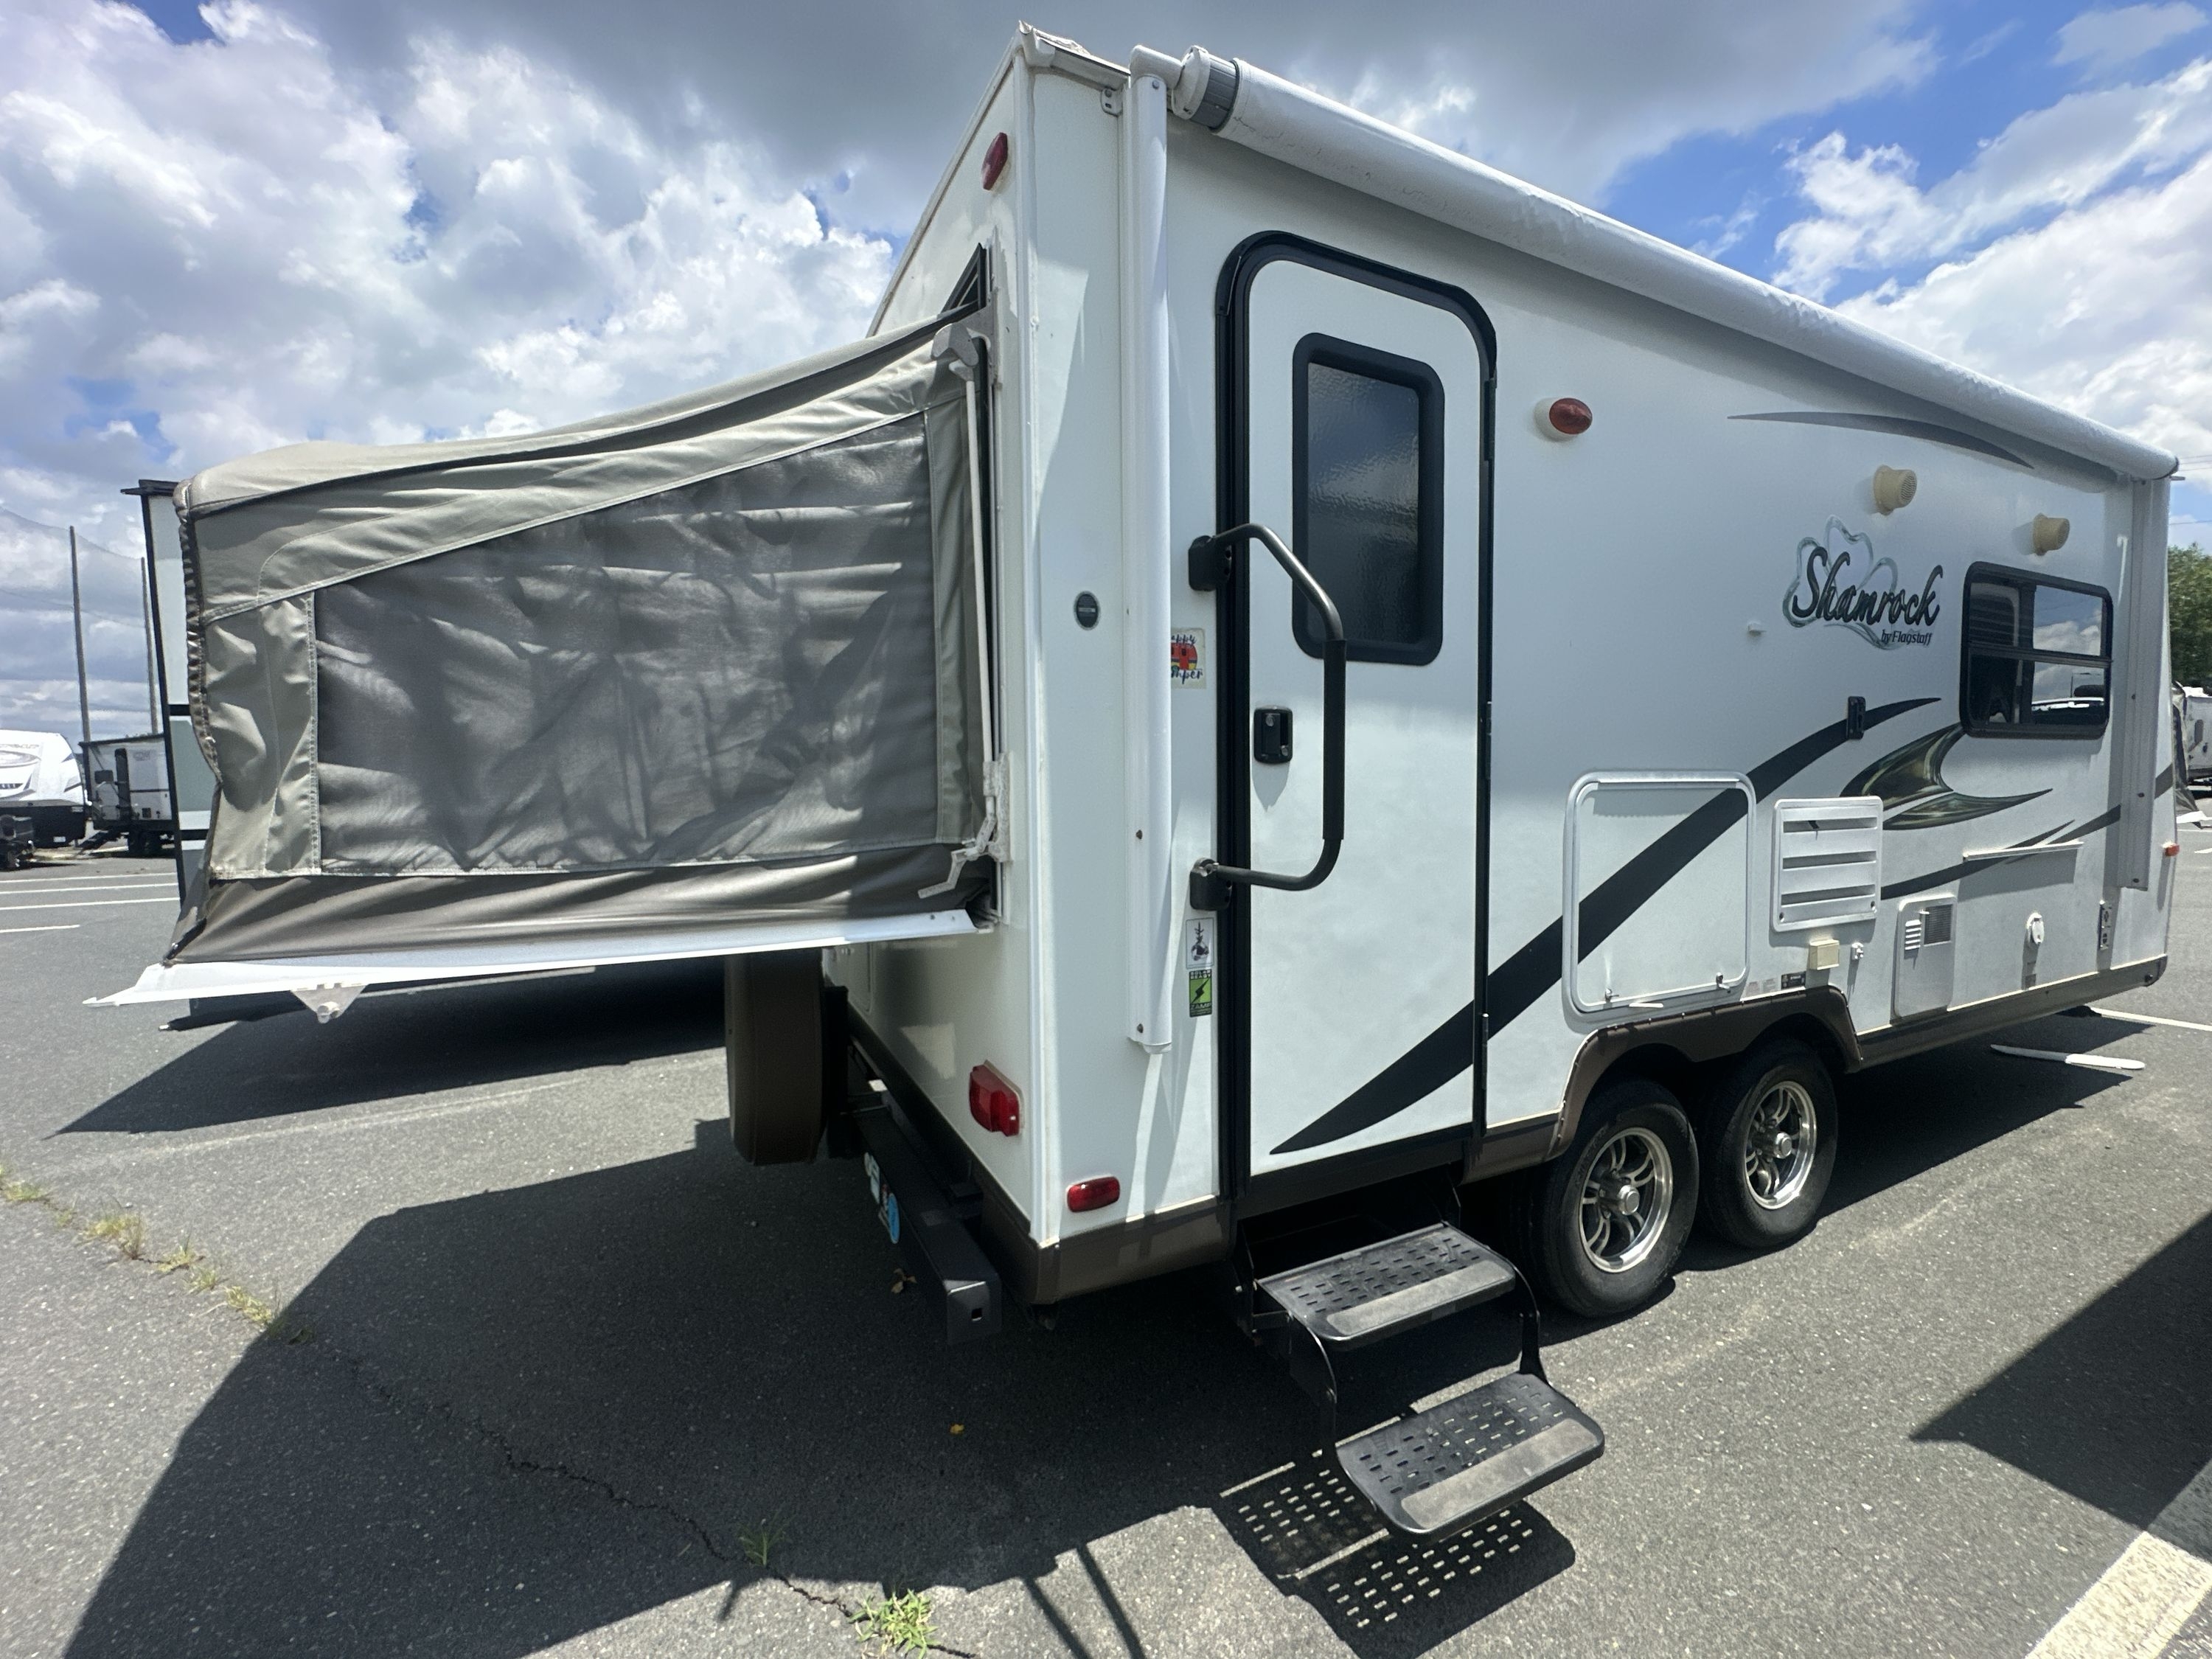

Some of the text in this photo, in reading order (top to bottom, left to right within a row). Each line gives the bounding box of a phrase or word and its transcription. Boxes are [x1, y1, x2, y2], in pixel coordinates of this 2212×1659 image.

[1792, 546, 1944, 627] Shamrock
[1881, 629, 1933, 646] by Flagstaff
